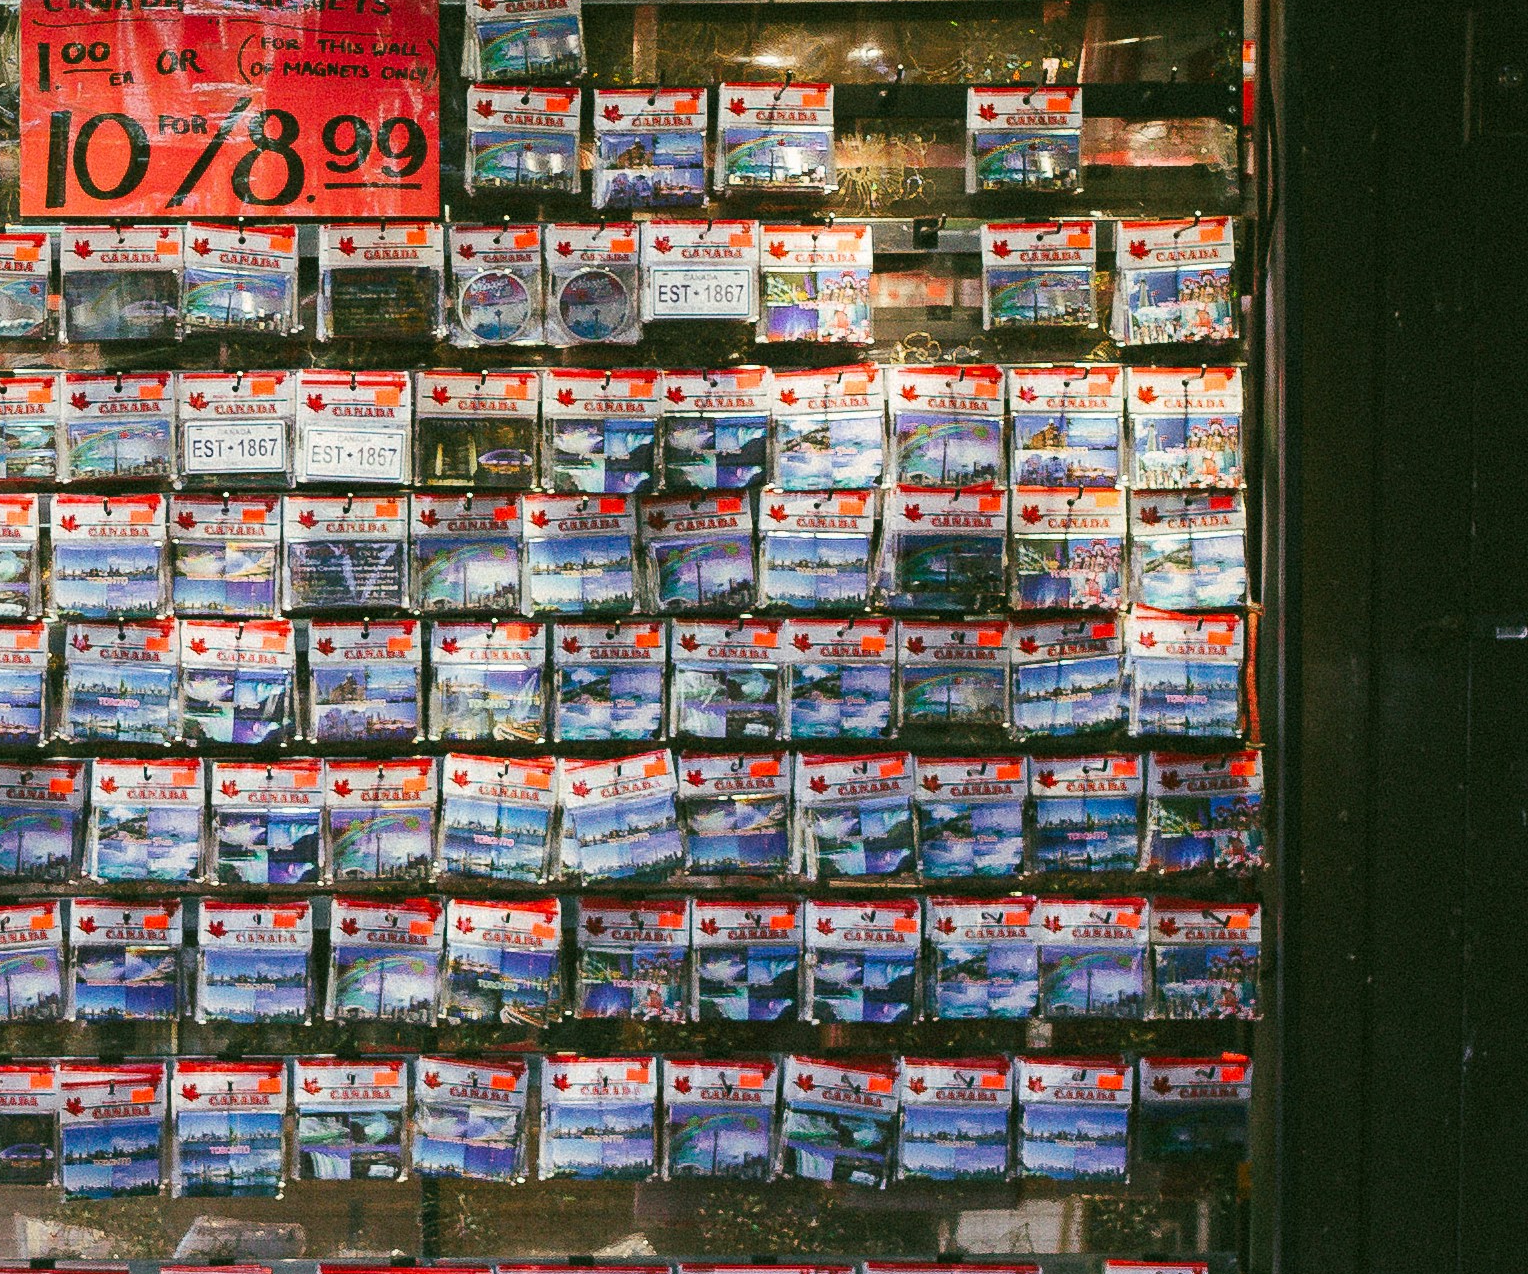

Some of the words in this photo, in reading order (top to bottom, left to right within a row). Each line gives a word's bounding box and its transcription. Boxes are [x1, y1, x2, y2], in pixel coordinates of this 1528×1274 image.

[505, 0, 568, 13] CANADA
[317, 39, 364, 54] THIS
[156, 49, 204, 75] OR
[283, 61, 370, 78] MAGNETS
[503, 113, 564, 127] CANADA
[756, 110, 817, 122] CANADA
[1006, 115, 1067, 126] CANADA
[44, 111, 151, 209] 10
[101, 253, 161, 263] CANADA
[364, 249, 419, 259] CANADA
[682, 248, 742, 259] CANADA
[795, 253, 857, 263] CANADA
[1020, 251, 1081, 262] CANADA
[1156, 249, 1219, 261] CANADA
[220, 253, 280, 269] CANADA
[704, 283, 744, 303] 1867
[99, 402, 161, 414] CANADA
[584, 401, 646, 412] CANADA
[694, 398, 754, 408] CANADA
[927, 399, 988, 411] CANADA
[214, 404, 277, 415] CANADA
[332, 406, 395, 418] CANADA
[238, 438, 278, 458] 1867
[559, 518, 620, 530] CANADA
[796, 518, 858, 529] CANADA
[931, 516, 992, 527] CANADA
[1048, 518, 1109, 528] CANADA
[88, 528, 149, 537] CANADA
[326, 523, 388, 534] CANADA
[100, 649, 161, 663] CANADA
[590, 648, 651, 659] CANADA
[708, 648, 769, 659] CANADA
[934, 649, 996, 661] CANADA
[715, 780, 775, 790] CANADA
[1066, 781, 1127, 792] CANADA
[127, 789, 188, 800] CANADA
[479, 785, 539, 802] CANADA
[483, 932, 543, 946] CANADA
[965, 928, 1027, 939] CANADA
[1072, 928, 1134, 939] CANADA
[209, 1095, 270, 1105] CANADA
[701, 1090, 762, 1102] CANADA
[936, 1090, 997, 1102] CANADA
[92, 1105, 151, 1119] CANADA
